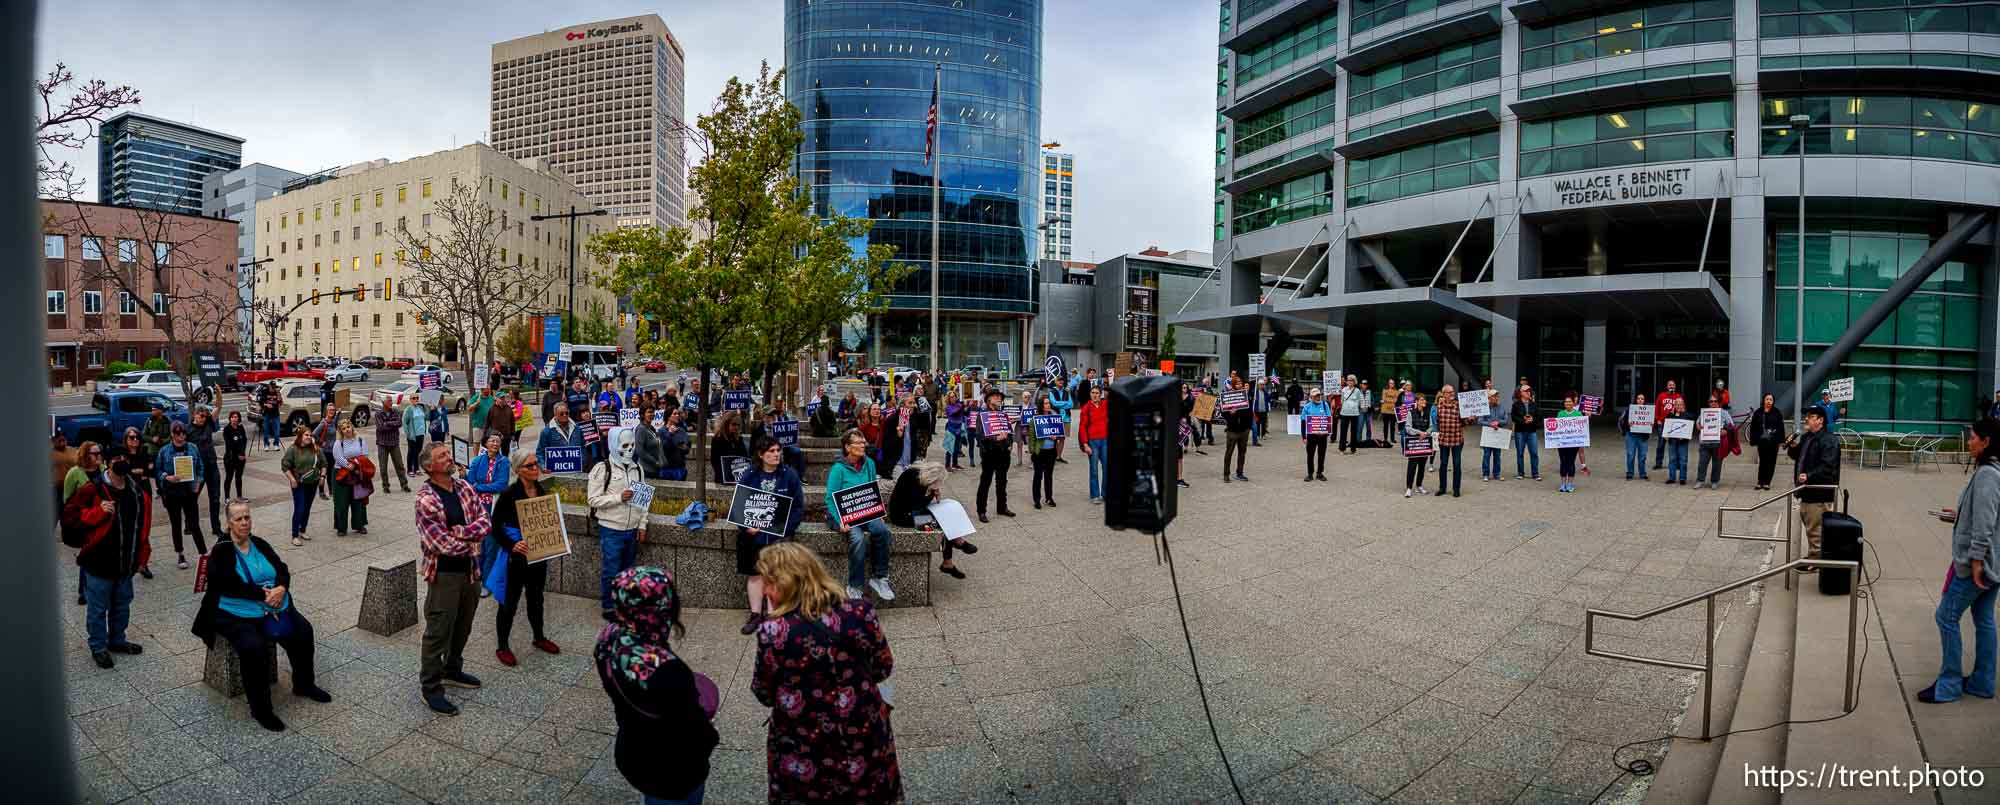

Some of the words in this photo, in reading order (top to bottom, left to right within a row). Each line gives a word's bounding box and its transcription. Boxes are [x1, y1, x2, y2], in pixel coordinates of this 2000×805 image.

[587, 22, 643, 38] KeyBank
[1554, 175, 1611, 192] WALLACE
[1617, 174, 1626, 186] F.
[1631, 168, 1691, 185] BENNETT
[1561, 189, 1616, 205] FEDERAL
[1622, 183, 1683, 199] BUILDING
[1036, 417, 1049, 425] TAX
[1051, 416, 1063, 424] THE
[773, 425, 786, 433] TAX
[787, 423, 798, 431] THE
[1043, 427, 1060, 435] RICH
[548, 450, 563, 459] TAX
[564, 449, 580, 458] THE
[554, 462, 574, 470] RICH
[753, 493, 772, 501] MAKE
[841, 493, 853, 501] DUE
[852, 487, 874, 498] PROCESS
[854, 493, 879, 504] OPTIONAL
[523, 498, 553, 516] FREE
[745, 499, 779, 508] BILLIONAIRES
[522, 511, 560, 532] ABREGO
[744, 519, 771, 528] EXTINCT
[527, 529, 563, 553] GARCIA
